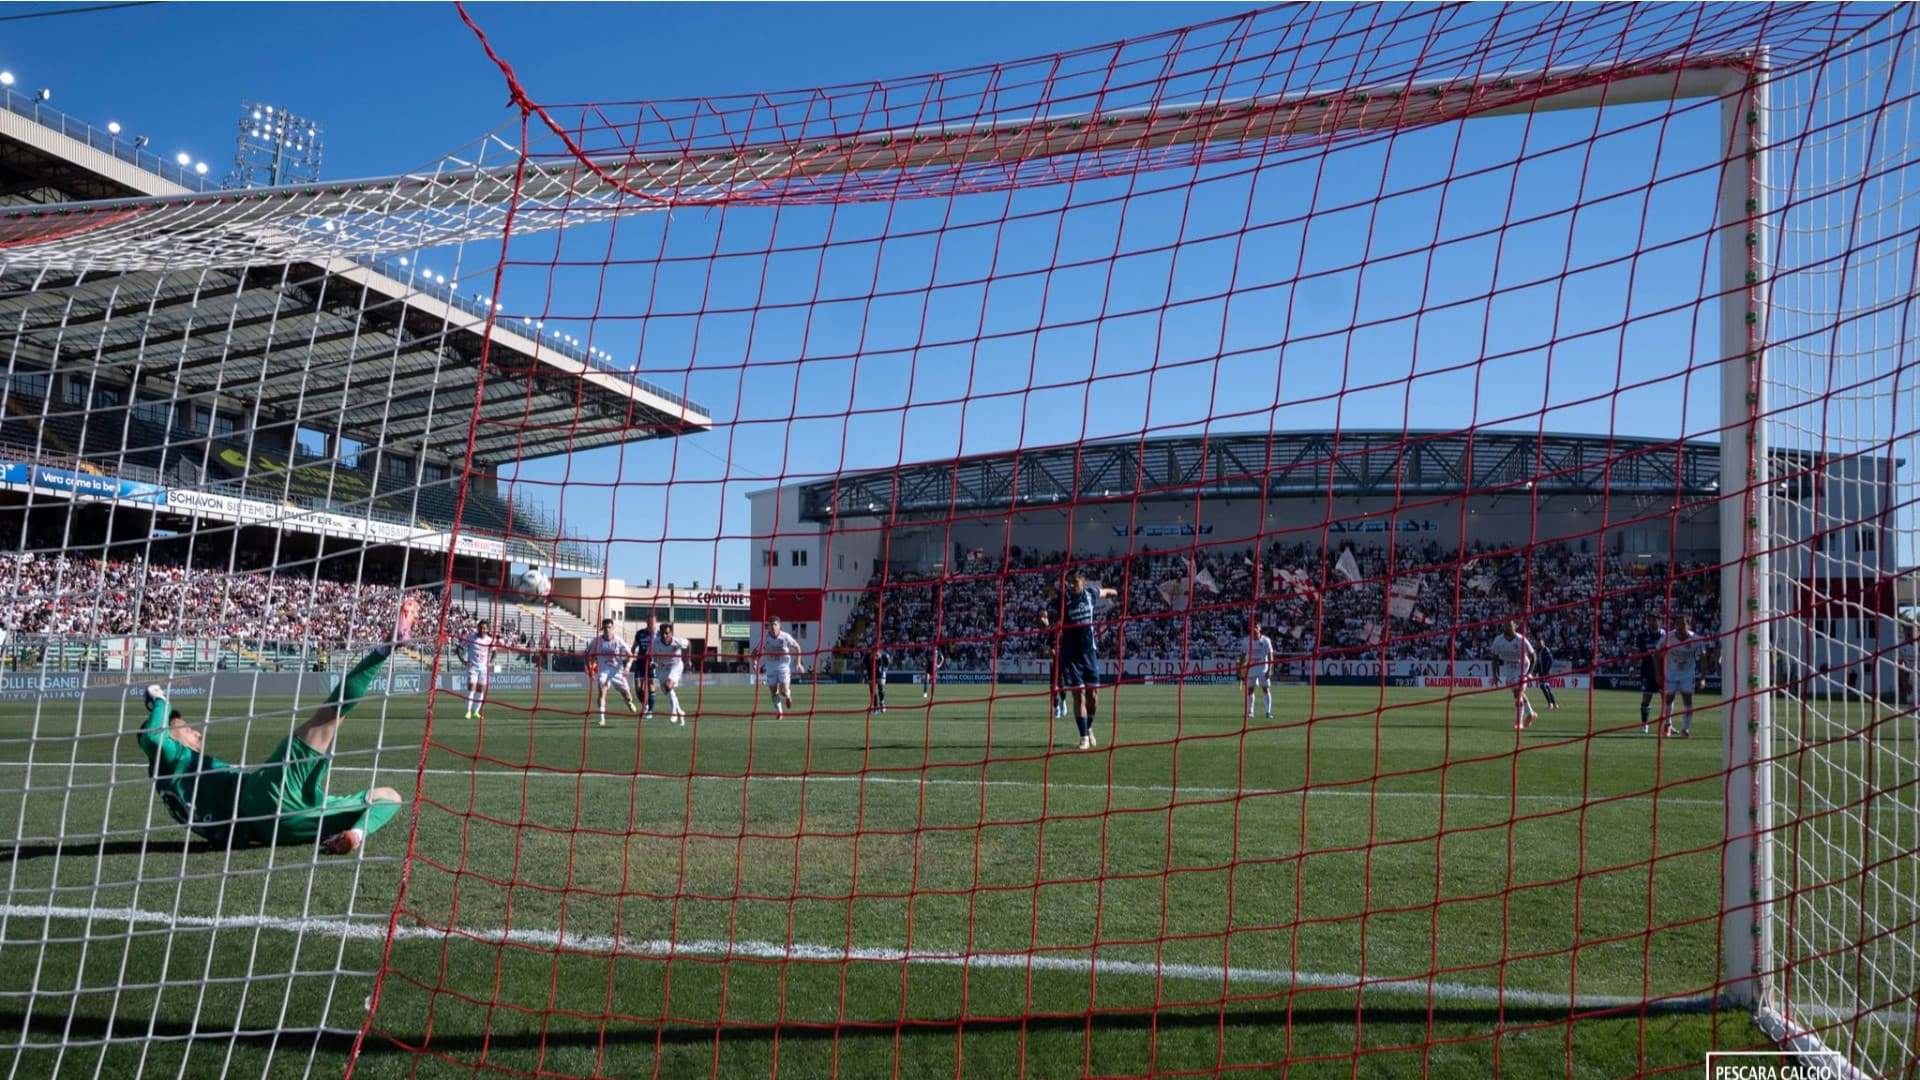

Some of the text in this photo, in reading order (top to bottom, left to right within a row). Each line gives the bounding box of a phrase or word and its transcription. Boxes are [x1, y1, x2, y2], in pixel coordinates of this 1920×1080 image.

[42, 471, 64, 484] Vera
[65, 476, 92, 489] come
[92, 479, 102, 490] la
[169, 491, 223, 509] SCHIAVON
[378, 524, 413, 538] MOSAIC
[697, 592, 745, 605] COMUNE
[27, 676, 80, 689] EUGANEI
[1454, 677, 1483, 688] PADOVA
[33, 691, 81, 699] IALIANO
